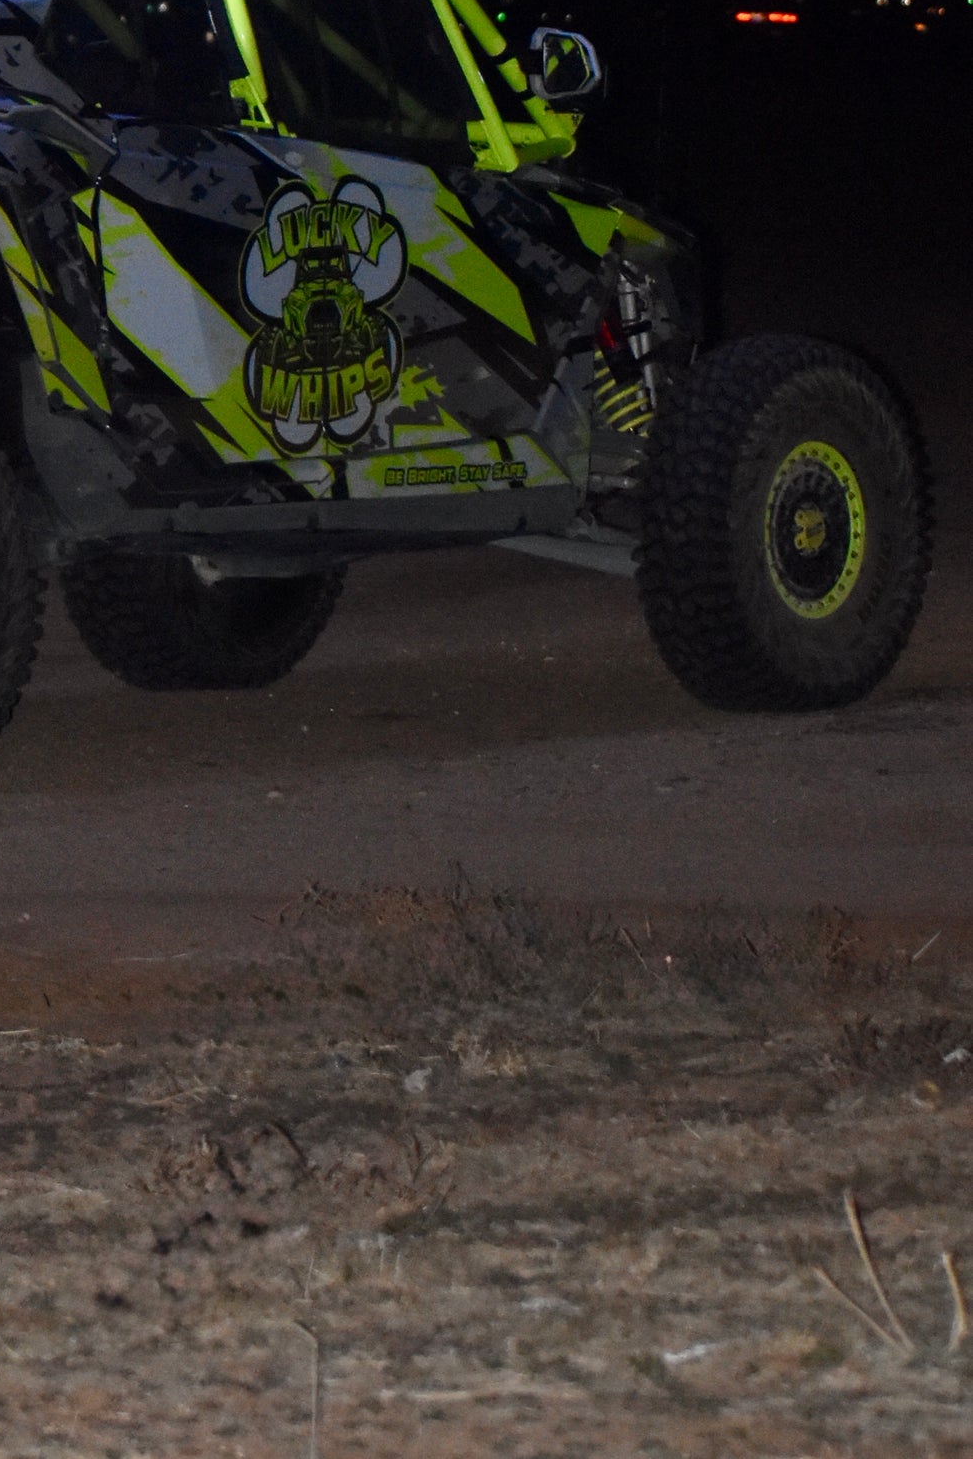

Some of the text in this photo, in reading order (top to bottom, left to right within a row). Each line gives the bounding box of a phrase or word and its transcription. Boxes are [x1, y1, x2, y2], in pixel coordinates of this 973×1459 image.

[256, 201, 397, 277] LUCKY
[260, 347, 392, 423] WHIPS
[386, 468, 404, 486] BE
[459, 464, 491, 482] STAY
